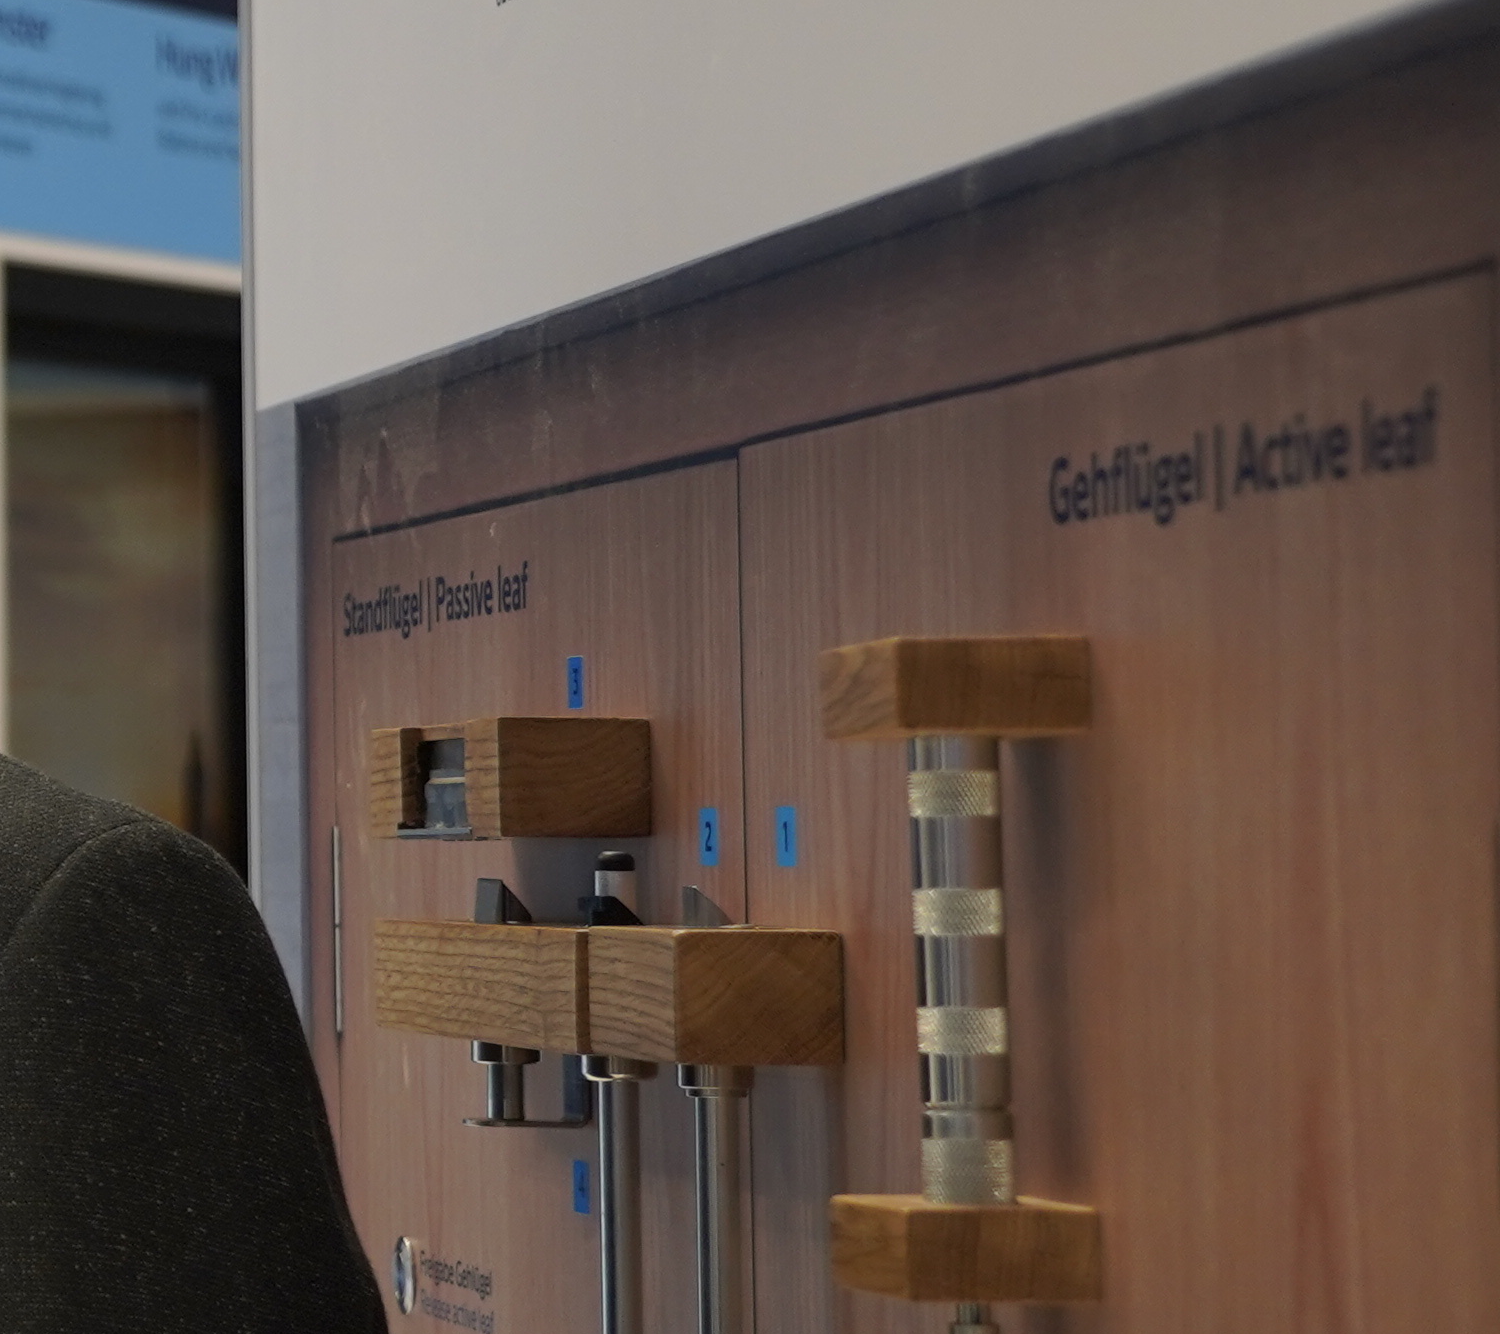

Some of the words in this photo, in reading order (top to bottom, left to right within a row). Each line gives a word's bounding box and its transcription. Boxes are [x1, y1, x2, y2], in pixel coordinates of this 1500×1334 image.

[1049, 431, 1205, 526] Gehflügel
[1234, 412, 1351, 494] Active
[1360, 386, 1439, 472] leaf
[343, 580, 422, 639] Standflügel
[435, 571, 492, 622] Passive
[498, 561, 528, 612] leaf
[705, 821, 712, 851] 2
